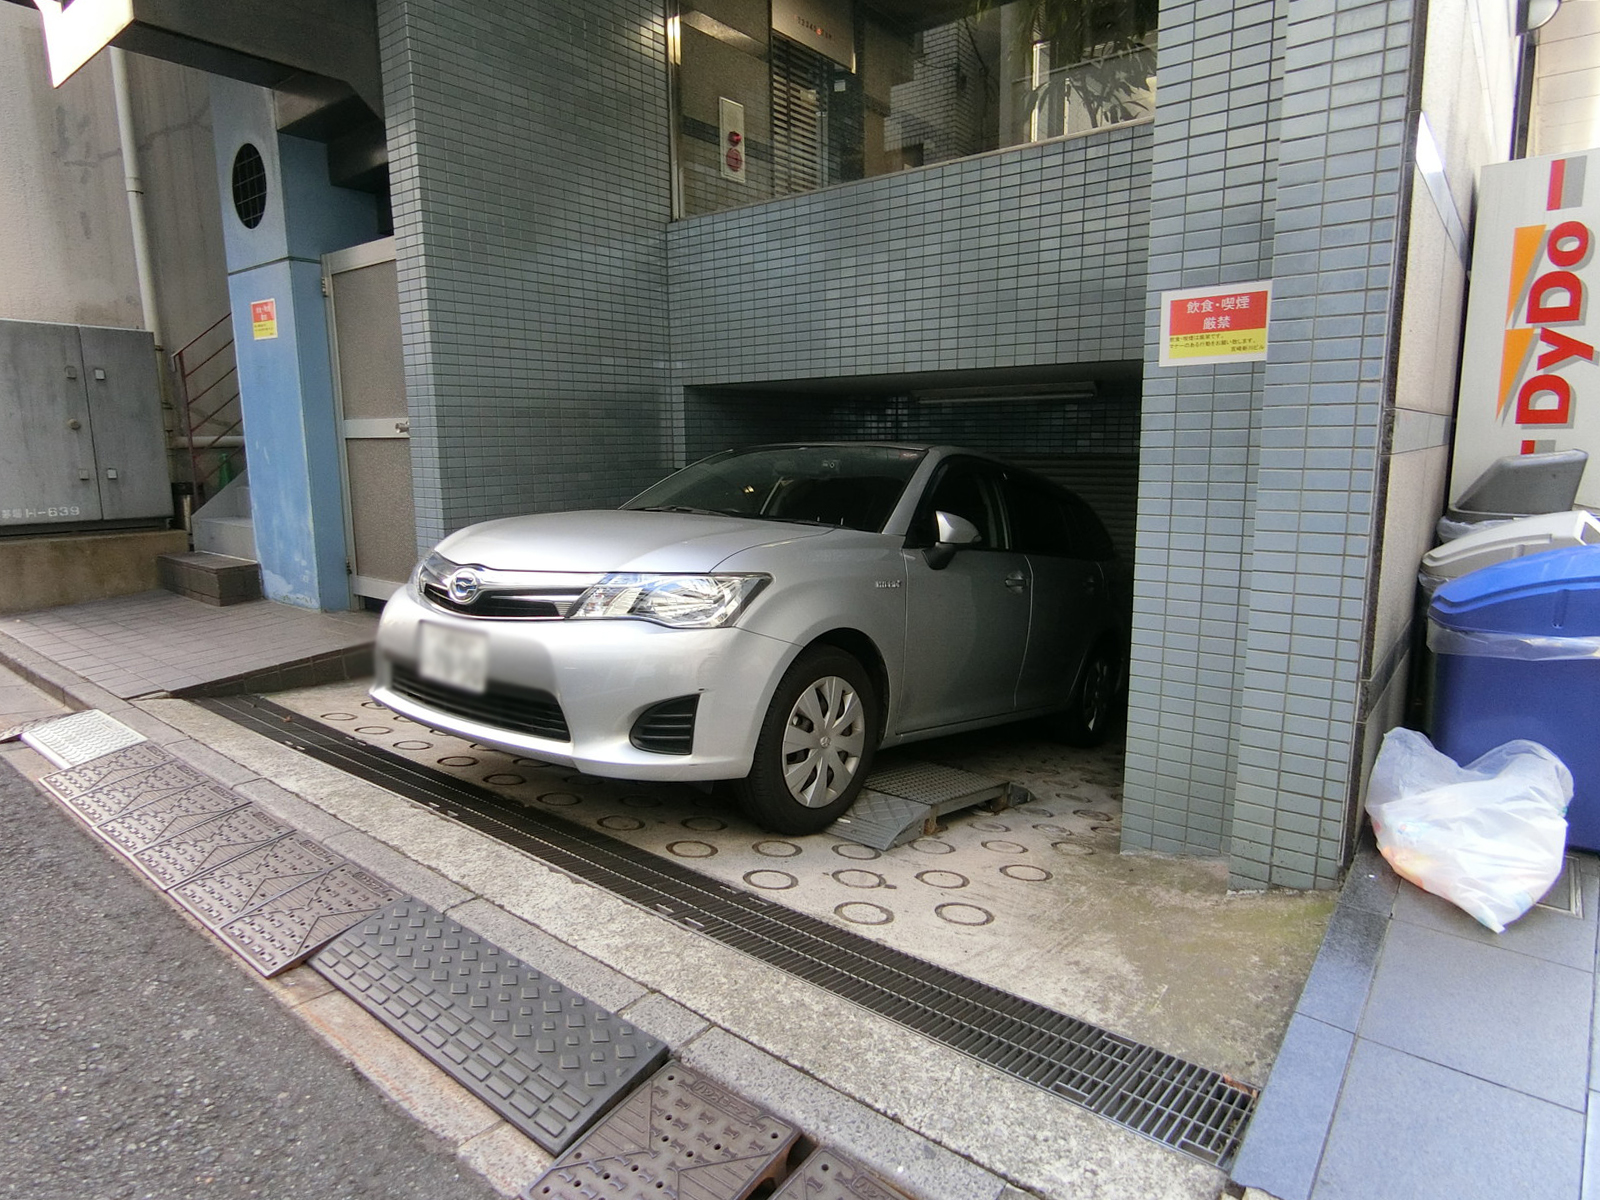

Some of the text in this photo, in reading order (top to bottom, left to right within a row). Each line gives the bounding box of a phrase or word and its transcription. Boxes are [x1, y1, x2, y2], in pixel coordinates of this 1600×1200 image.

[1186, 295, 1250, 314] 飲食・喫煙
[1202, 315, 1231, 330] 厳禁
[1515, 221, 1594, 425] DyDo
